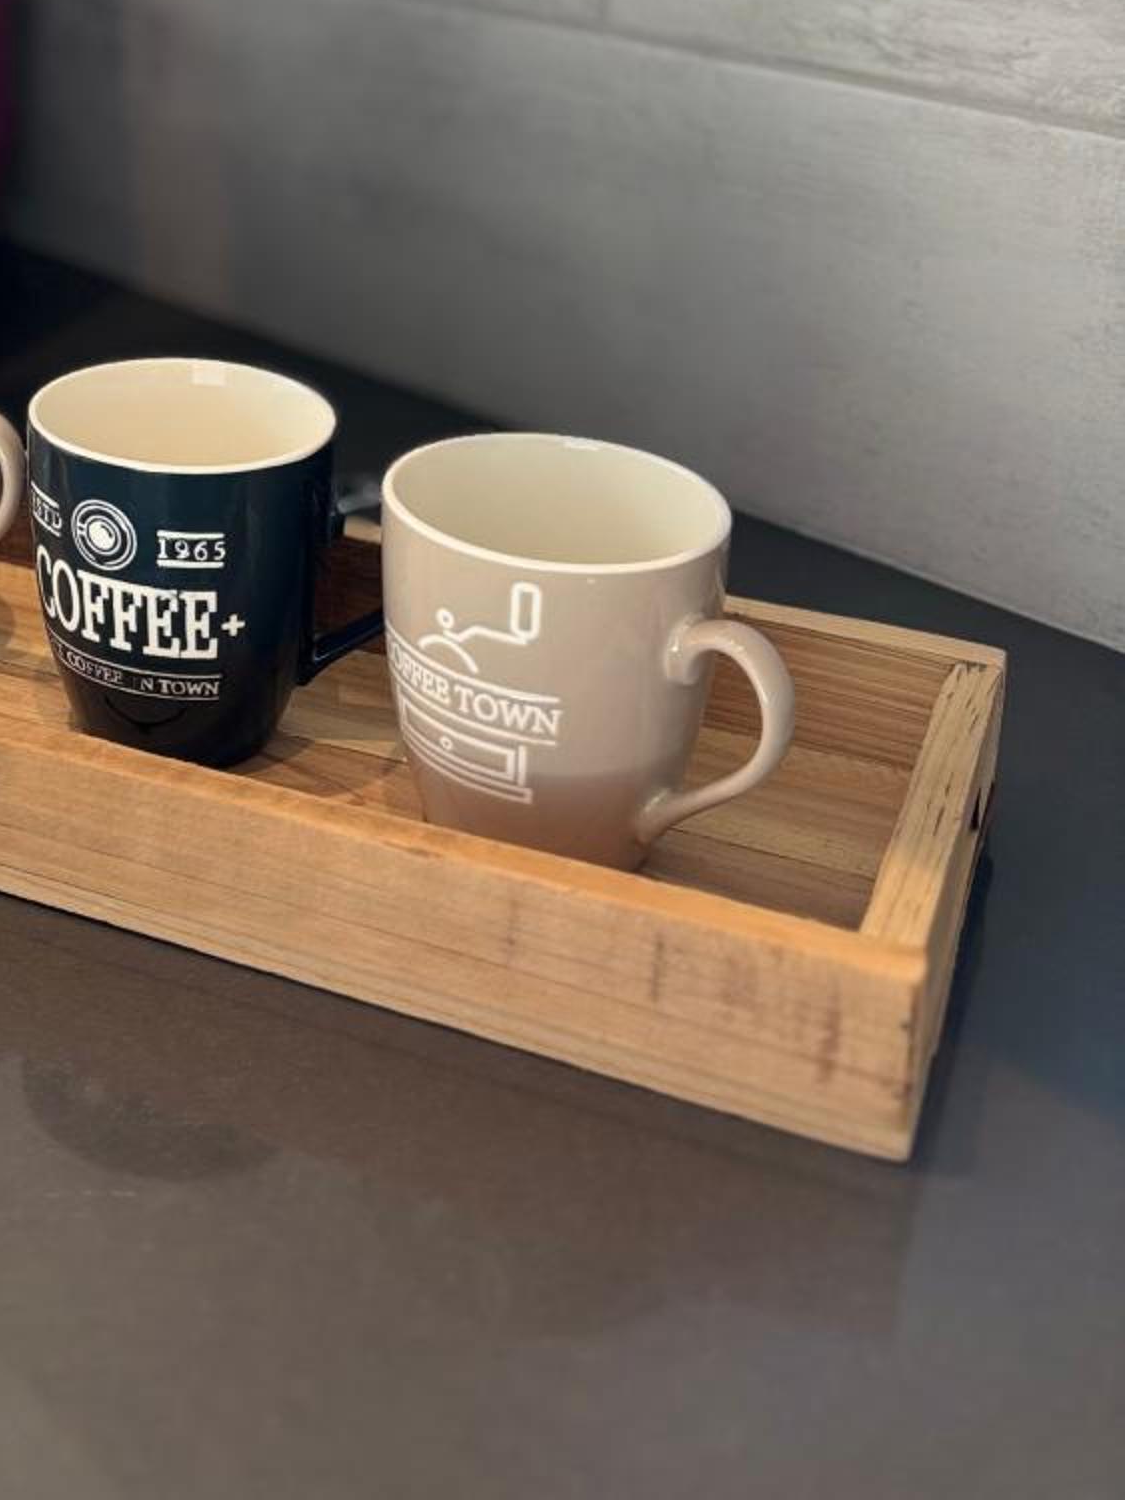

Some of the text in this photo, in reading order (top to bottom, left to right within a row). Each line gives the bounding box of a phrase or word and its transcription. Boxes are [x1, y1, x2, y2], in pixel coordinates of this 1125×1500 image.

[156, 537, 226, 561] 1965
[66, 652, 124, 685] COFFEE
[158, 678, 220, 696] TOWN
[454, 684, 563, 736] TOWN
